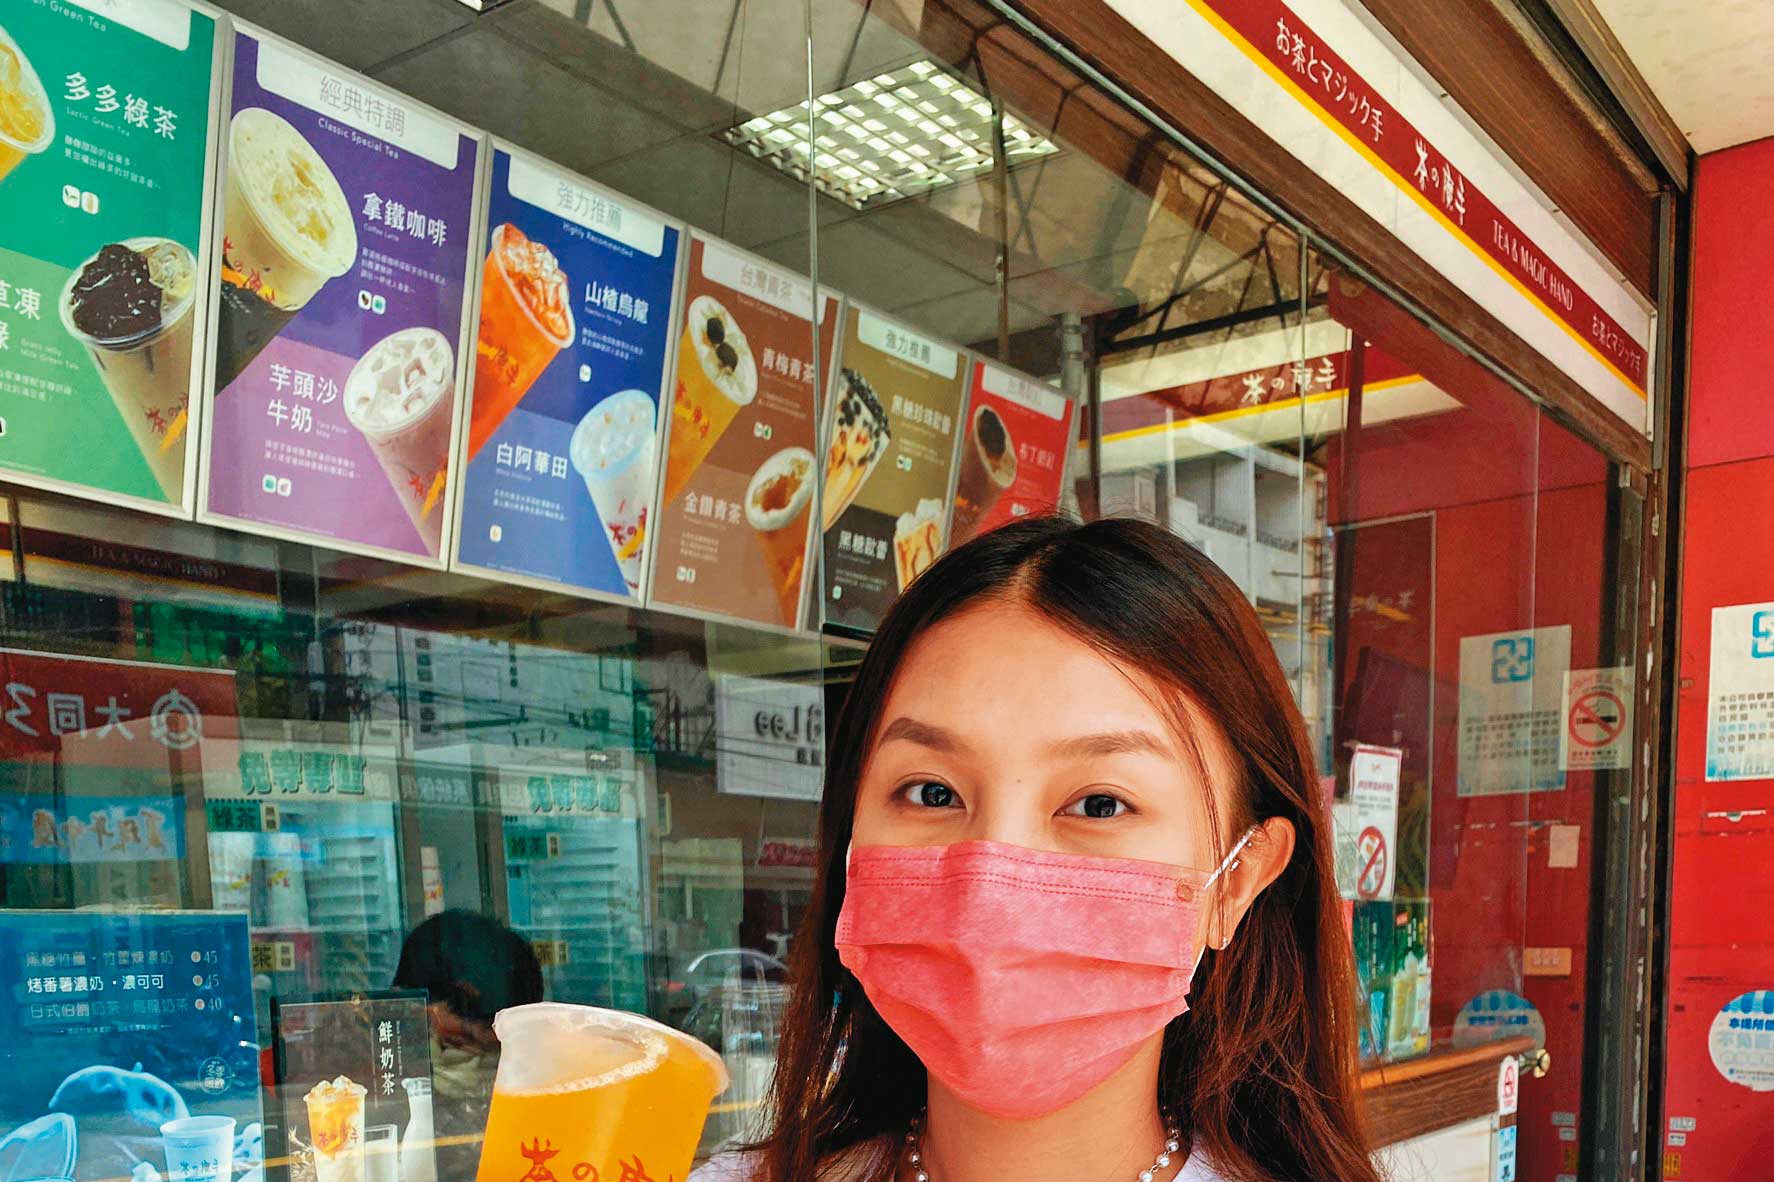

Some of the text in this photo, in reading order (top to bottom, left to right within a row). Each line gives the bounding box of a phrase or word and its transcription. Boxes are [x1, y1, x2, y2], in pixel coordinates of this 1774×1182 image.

[50, 1, 84, 22] Green
[88, 15, 107, 32] Tea
[1276, 17, 1384, 142] お茶とマジック手
[64, 72, 178, 140] 多多綠茶
[91, 116, 114, 130] Green
[318, 75, 406, 138] 經典特調
[317, 117, 400, 160] Classic Special Tea
[361, 192, 448, 248] 拿鐵咖啡
[556, 181, 625, 232] 強力推薦
[1492, 219, 1574, 312] TEA & MAGIC HAND
[584, 281, 650, 325] 山楂烏龍
[269, 363, 339, 404] 芋頭沙
[267, 398, 313, 433] 牛奶
[496, 442, 568, 480] 白阿華田
[203, 951, 218, 964] 45
[377, 1020, 397, 1096] 鮮奶茶
